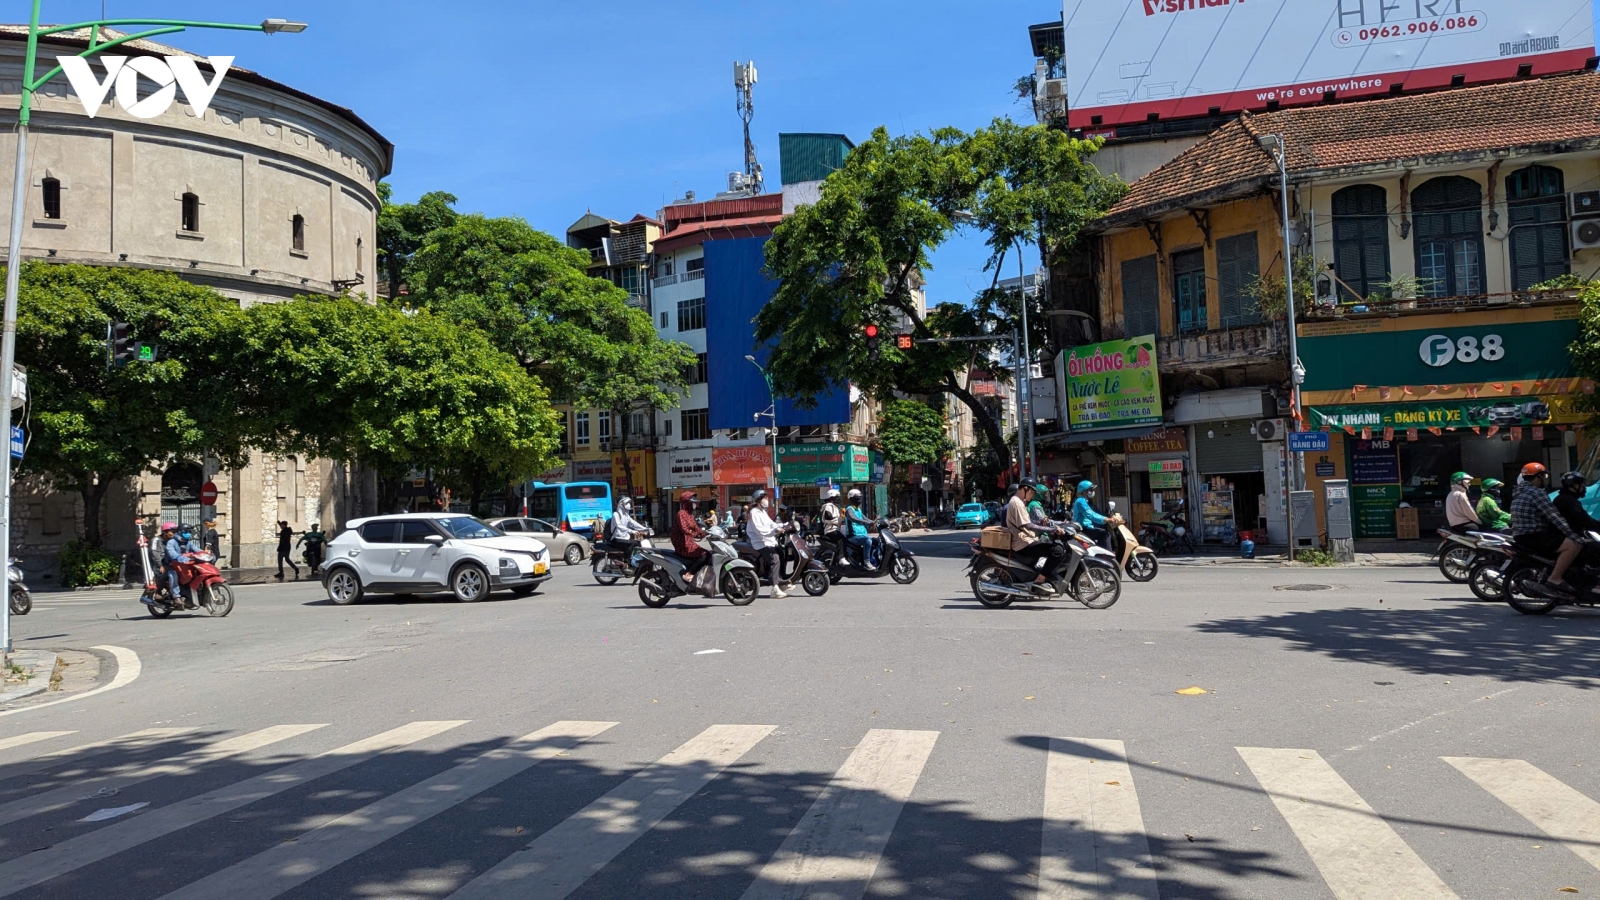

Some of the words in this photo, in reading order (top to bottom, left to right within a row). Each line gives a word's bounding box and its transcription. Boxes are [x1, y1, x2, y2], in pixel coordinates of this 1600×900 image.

[1359, 15, 1478, 41] 0962.906.086
[1299, 79, 1382, 97] everywhere
[899, 337, 911, 348] 36
[1419, 334, 1505, 367] F88
[1070, 379, 1102, 399] Nước
[1104, 375, 1120, 395] Lê
[1342, 412, 1381, 425] NHANH
[1446, 409, 1461, 422] XE
[1128, 441, 1159, 452] COFFEE
[1165, 440, 1183, 450] TEA
[1292, 440, 1311, 449] HÀNG
[1312, 440, 1326, 450] ĐẬU
[1371, 440, 1391, 450] MB
